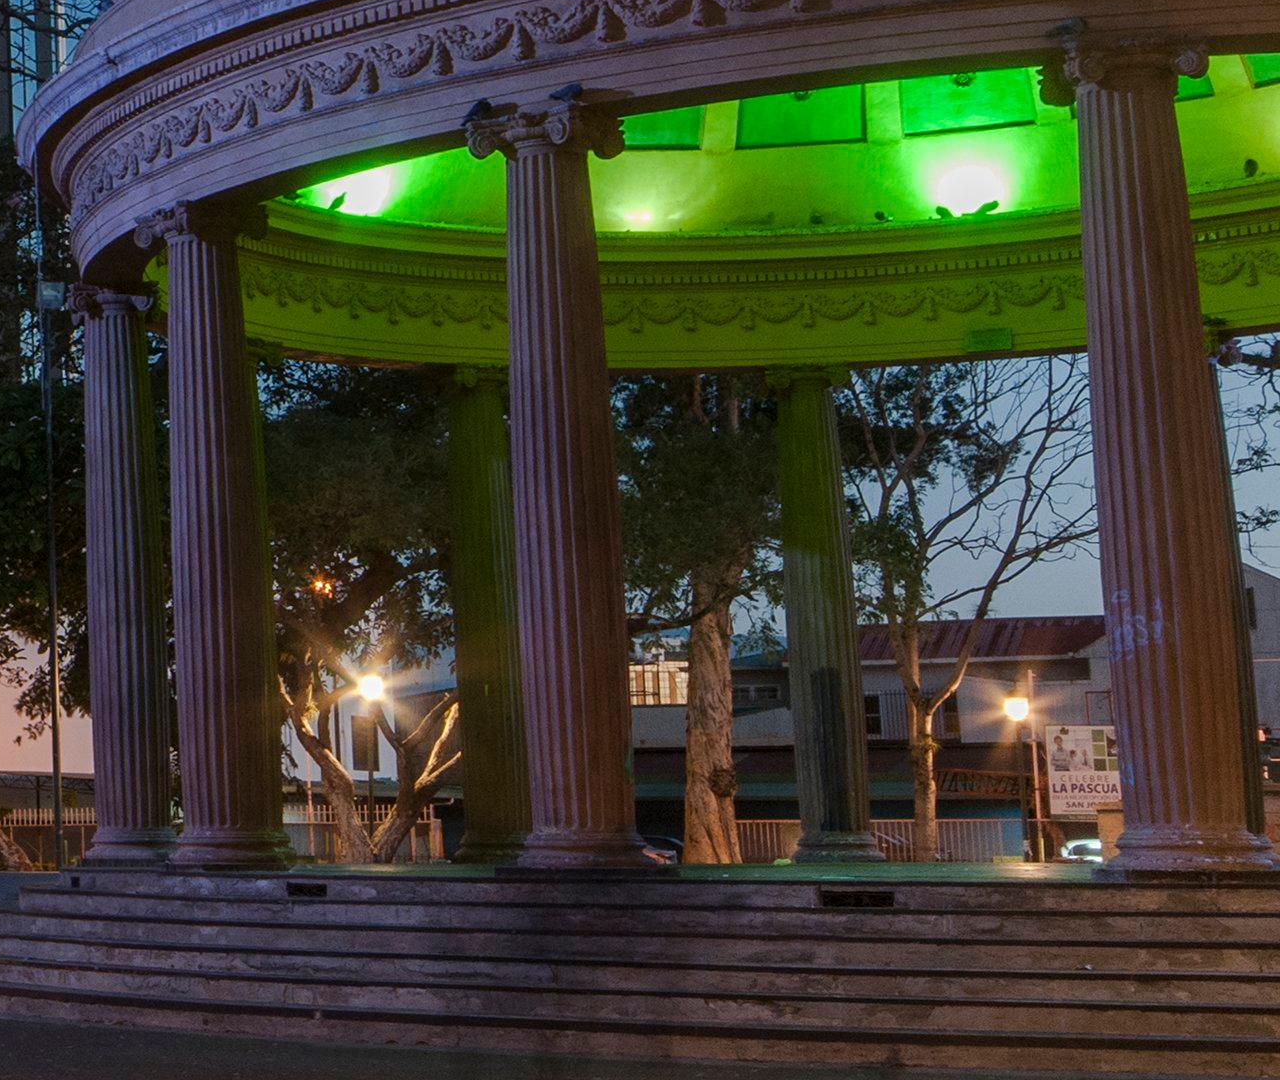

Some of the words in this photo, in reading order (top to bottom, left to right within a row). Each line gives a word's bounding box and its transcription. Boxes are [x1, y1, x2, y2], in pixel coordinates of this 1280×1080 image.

[1060, 774, 1110, 783] CELEBRE
[1053, 783, 1067, 793] LA
[1071, 783, 1118, 793] PASCUA
[1065, 801, 1084, 809] SAN
